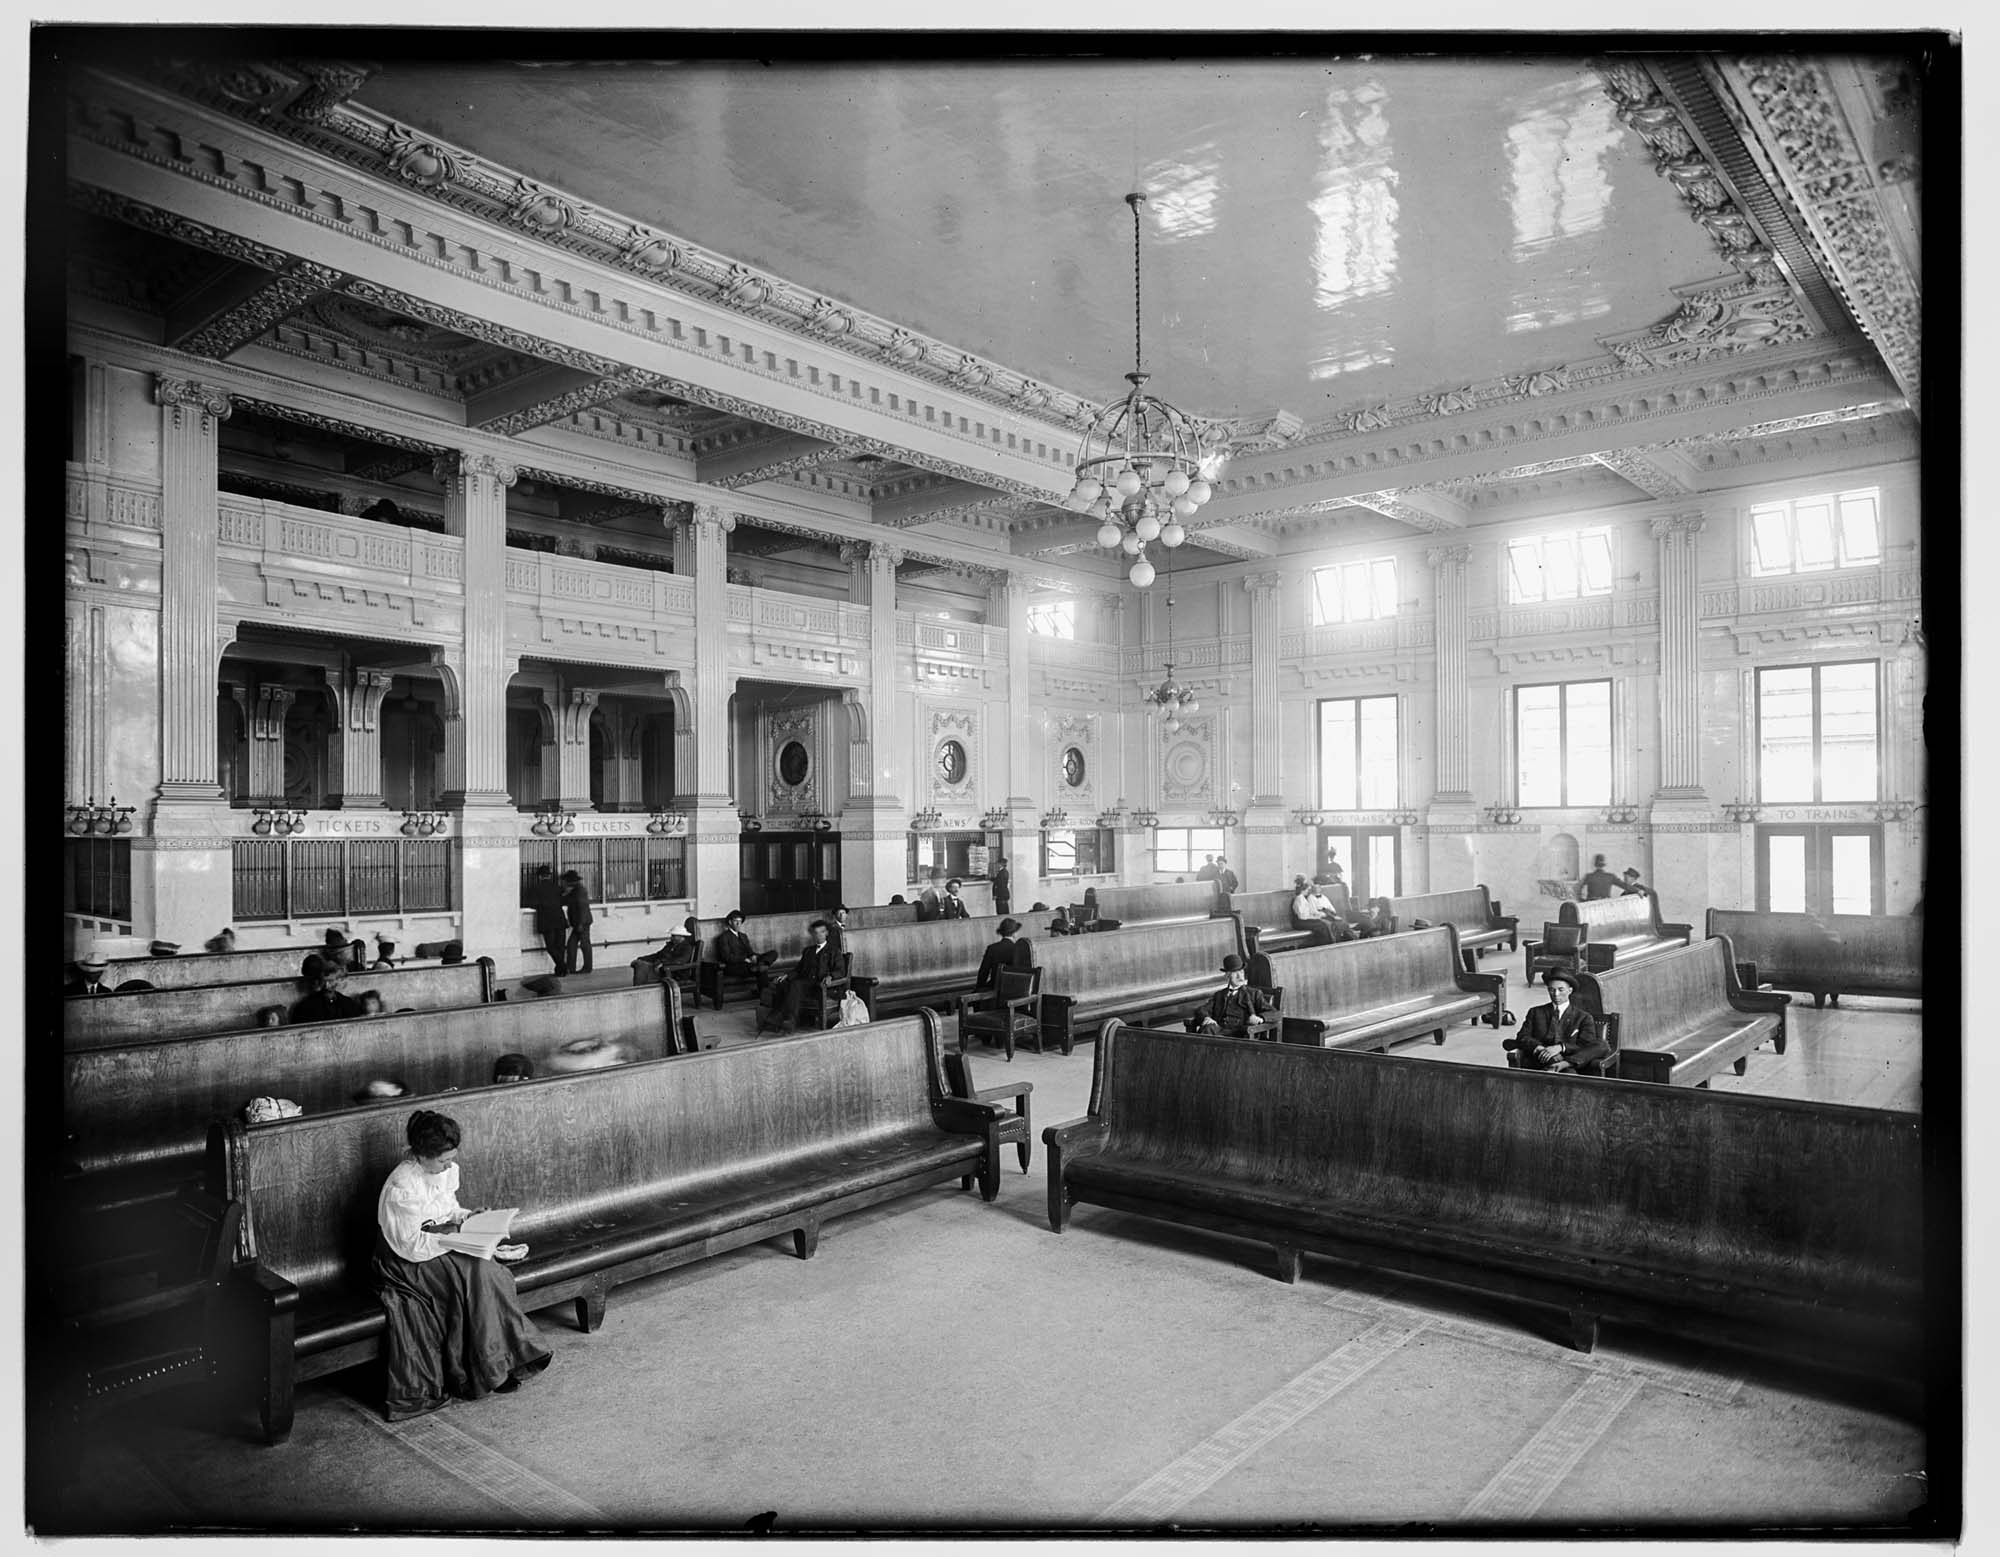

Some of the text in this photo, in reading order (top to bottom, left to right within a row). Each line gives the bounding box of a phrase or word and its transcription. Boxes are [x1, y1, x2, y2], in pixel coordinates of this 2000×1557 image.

[1777, 808, 1858, 820] TO TRAINS
[316, 820, 380, 833] TICKETS
[580, 820, 631, 833] TICKETS
[943, 818, 966, 828] NEWS
